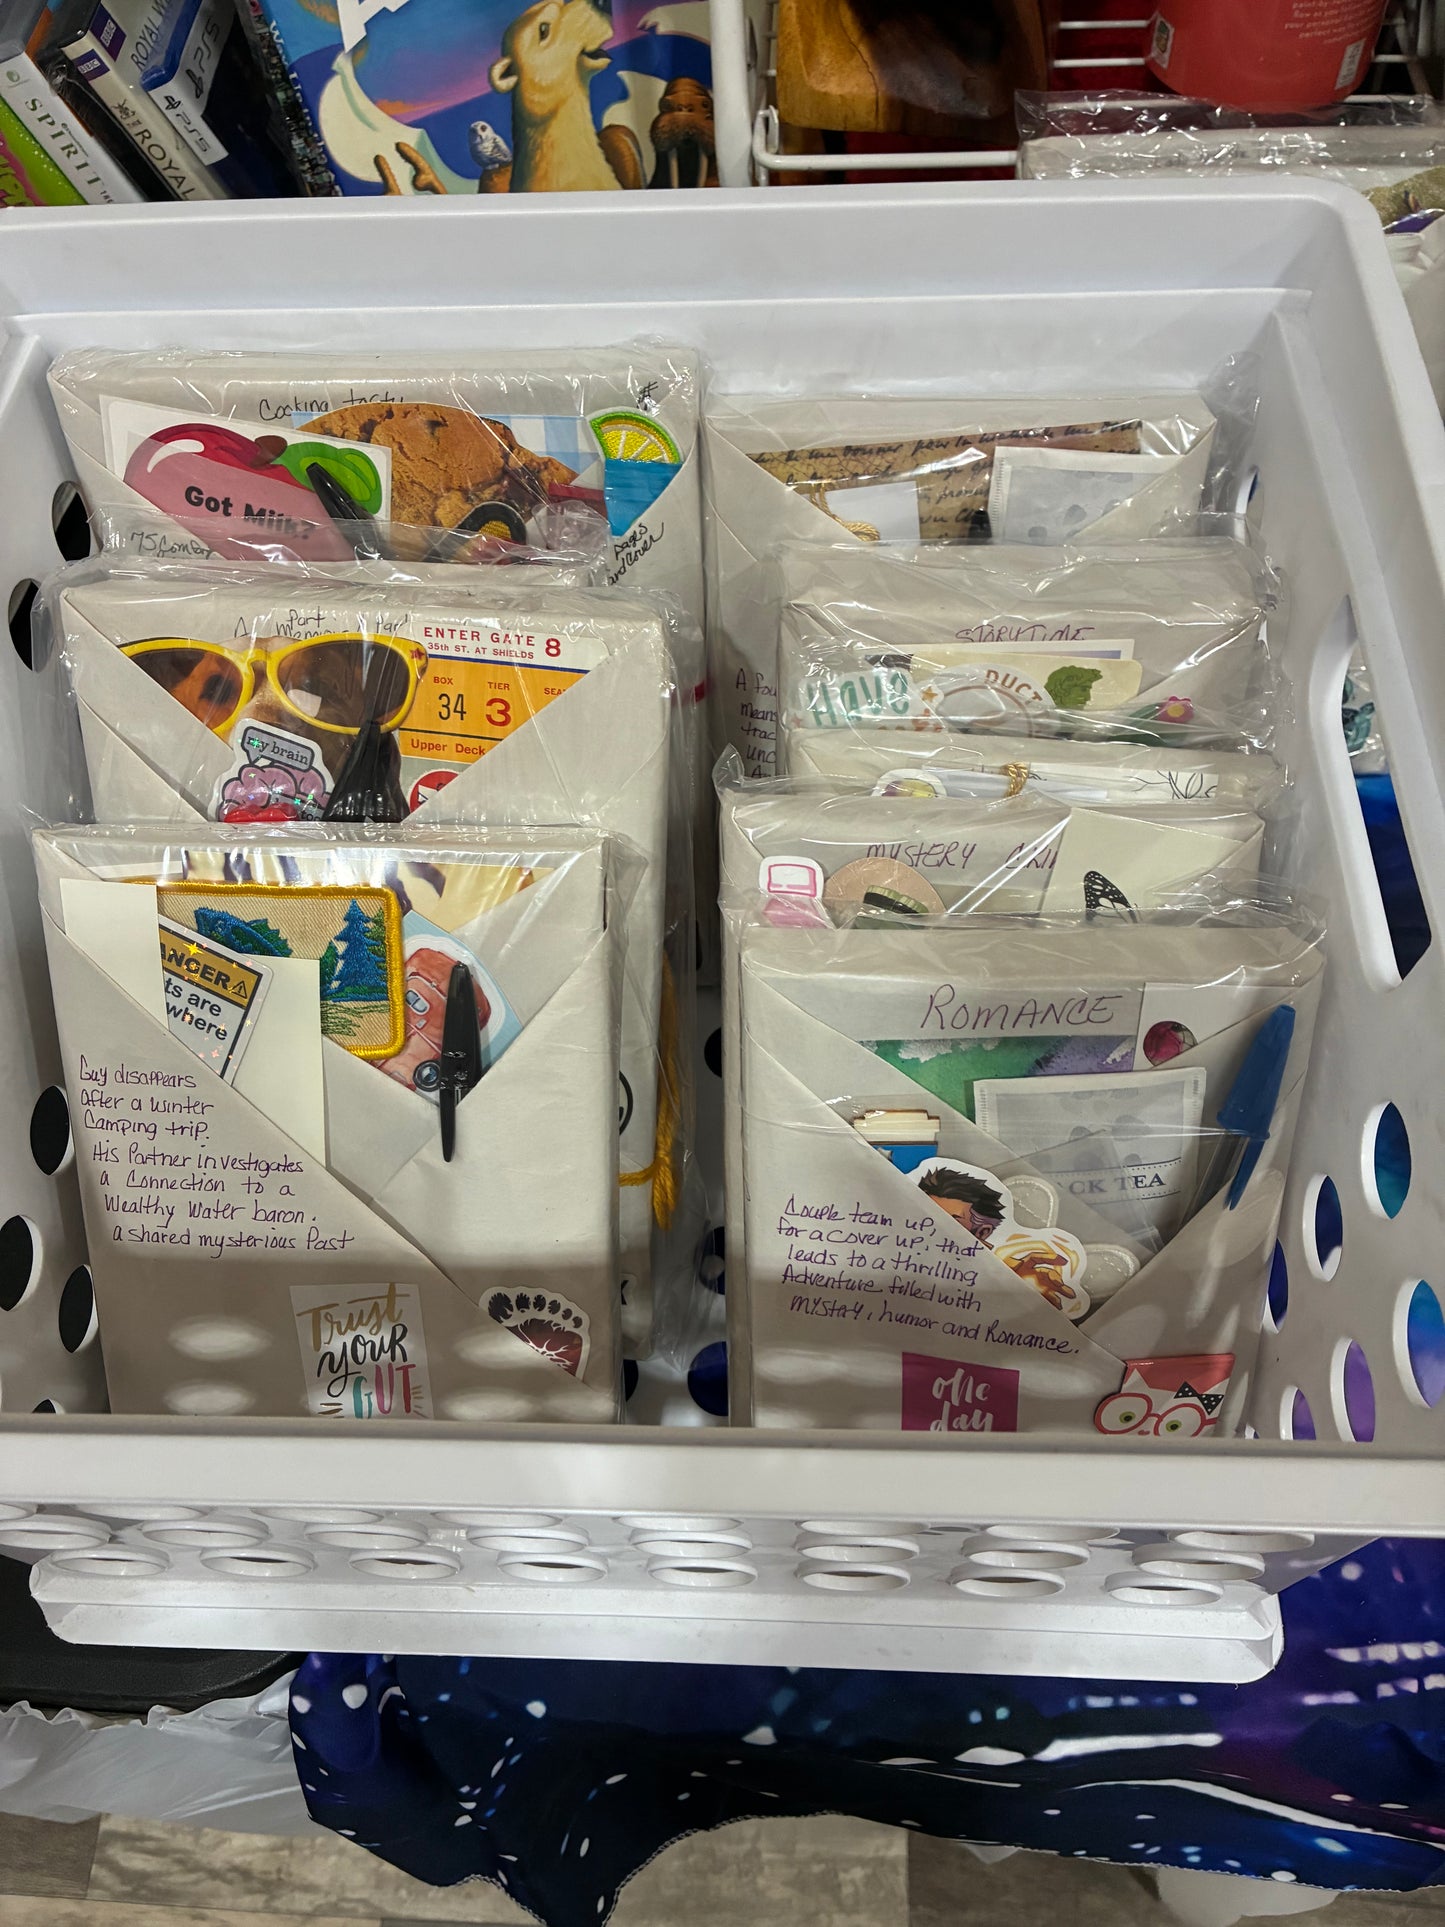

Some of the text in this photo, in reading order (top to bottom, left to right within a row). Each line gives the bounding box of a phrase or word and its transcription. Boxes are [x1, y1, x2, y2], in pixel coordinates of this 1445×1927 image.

[130, 17, 160, 71] ROYAL
[25, 98, 101, 185] SPIRIT
[176, 111, 211, 152] PS5
[135, 129, 195, 200] ROYAL
[184, 486, 233, 517] Got
[424, 627, 561, 657] ENTER GATE 8
[428, 642, 534, 659] 35th ST. AT SHIELDS
[433, 677, 566, 696] BOX TIER SEA
[736, 668, 777, 696] A fou
[985, 669, 1043, 704] DUCT
[438, 693, 512, 727] 34 3
[806, 672, 910, 726] Have
[741, 722, 777, 740] trac
[271, 741, 308, 766] brain
[411, 739, 485, 755] Upper Deck
[1005, 843, 1058, 869] CRI
[188, 992, 221, 1017] are
[166, 1002, 227, 1041] where
[80, 1054, 107, 1086] Guy
[131, 1098, 142, 1111] a
[93, 1139, 119, 1162] His
[100, 1170, 110, 1186] a
[241, 1176, 264, 1195] to
[280, 1184, 296, 1196] a
[1057, 1173, 1166, 1195] CK TEA
[849, 1202, 892, 1227] team
[113, 1225, 123, 1241] a
[128, 1224, 191, 1246] shared
[809, 1230, 823, 1242] a
[936, 1238, 984, 1257] that
[788, 1244, 979, 1287] leads to a thrilling
[889, 1275, 936, 1302] filled
[938, 1289, 981, 1312] with
[296, 1282, 410, 1352] Trust
[878, 1300, 939, 1329] humor
[942, 1322, 980, 1340] and
[353, 1363, 416, 1419] GUT
[932, 1368, 991, 1406] one
[930, 1400, 994, 1432] day
